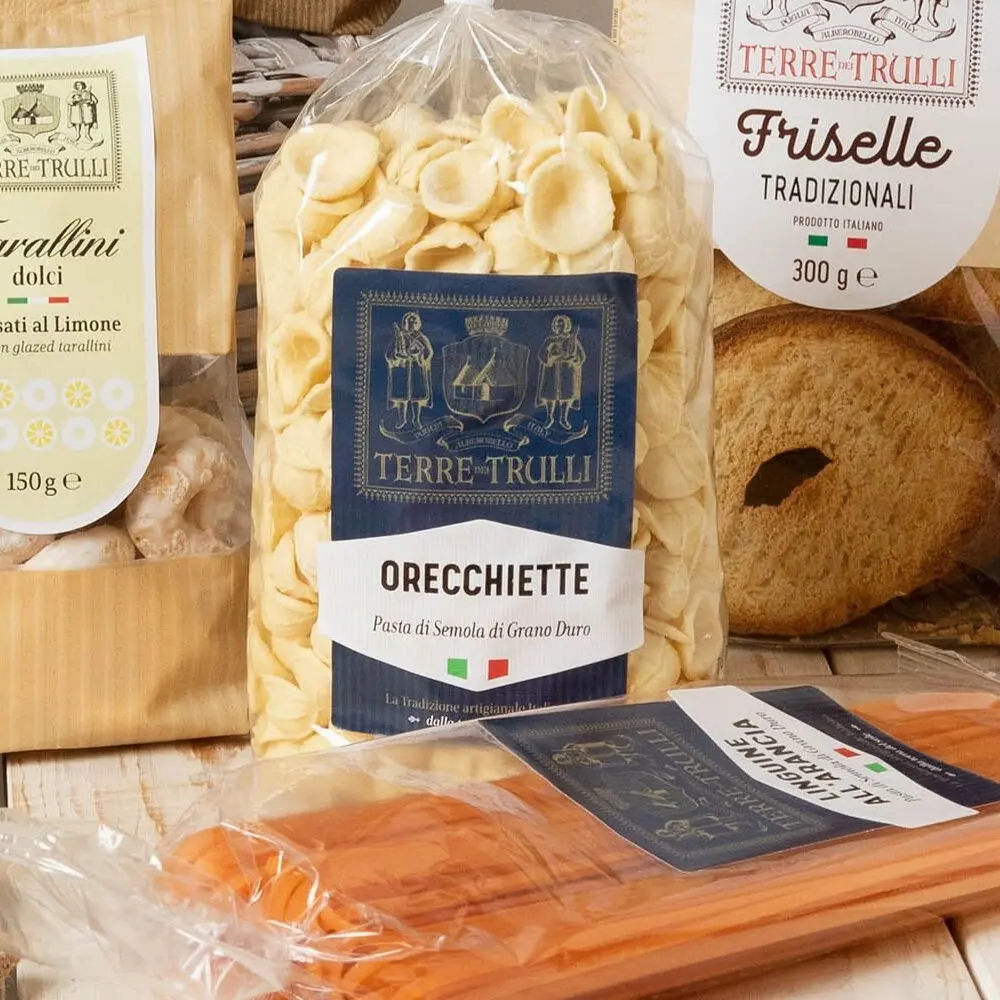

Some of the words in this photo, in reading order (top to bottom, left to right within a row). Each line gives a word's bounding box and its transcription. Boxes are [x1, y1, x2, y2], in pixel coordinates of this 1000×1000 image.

[820, 28, 880, 44] ALBEROBELLO
[738, 43, 838, 81] TERRE
[850, 51, 958, 88] TRULLI
[737, 108, 953, 170] Friselle
[37, 157, 108, 178] TRULLI
[761, 174, 913, 211] TRADIZIONALI
[793, 215, 840, 230] PRODOTTO
[843, 218, 884, 233] ITALIANO
[12, 265, 63, 287] dolci
[792, 258, 830, 284] 300
[32, 315, 48, 333] al
[54, 315, 122, 333] Limone
[13, 339, 54, 356] glazed
[58, 338, 112, 353] tarallini
[374, 451, 474, 484] TERRE
[486, 451, 593, 484] TRULLI
[380, 559, 590, 597] ORECCHIETTE
[372, 615, 411, 636] Pasta
[415, 620, 430, 636] di
[433, 619, 485, 638] Semola
[488, 621, 503, 639] di
[507, 621, 552, 639] Grano
[555, 620, 591, 638] Duro
[385, 693, 398, 705] La
[401, 697, 462, 713] Tradizione
[725, 738, 841, 802] LINGUINE
[732, 718, 892, 805] ALL'ARANCIA
